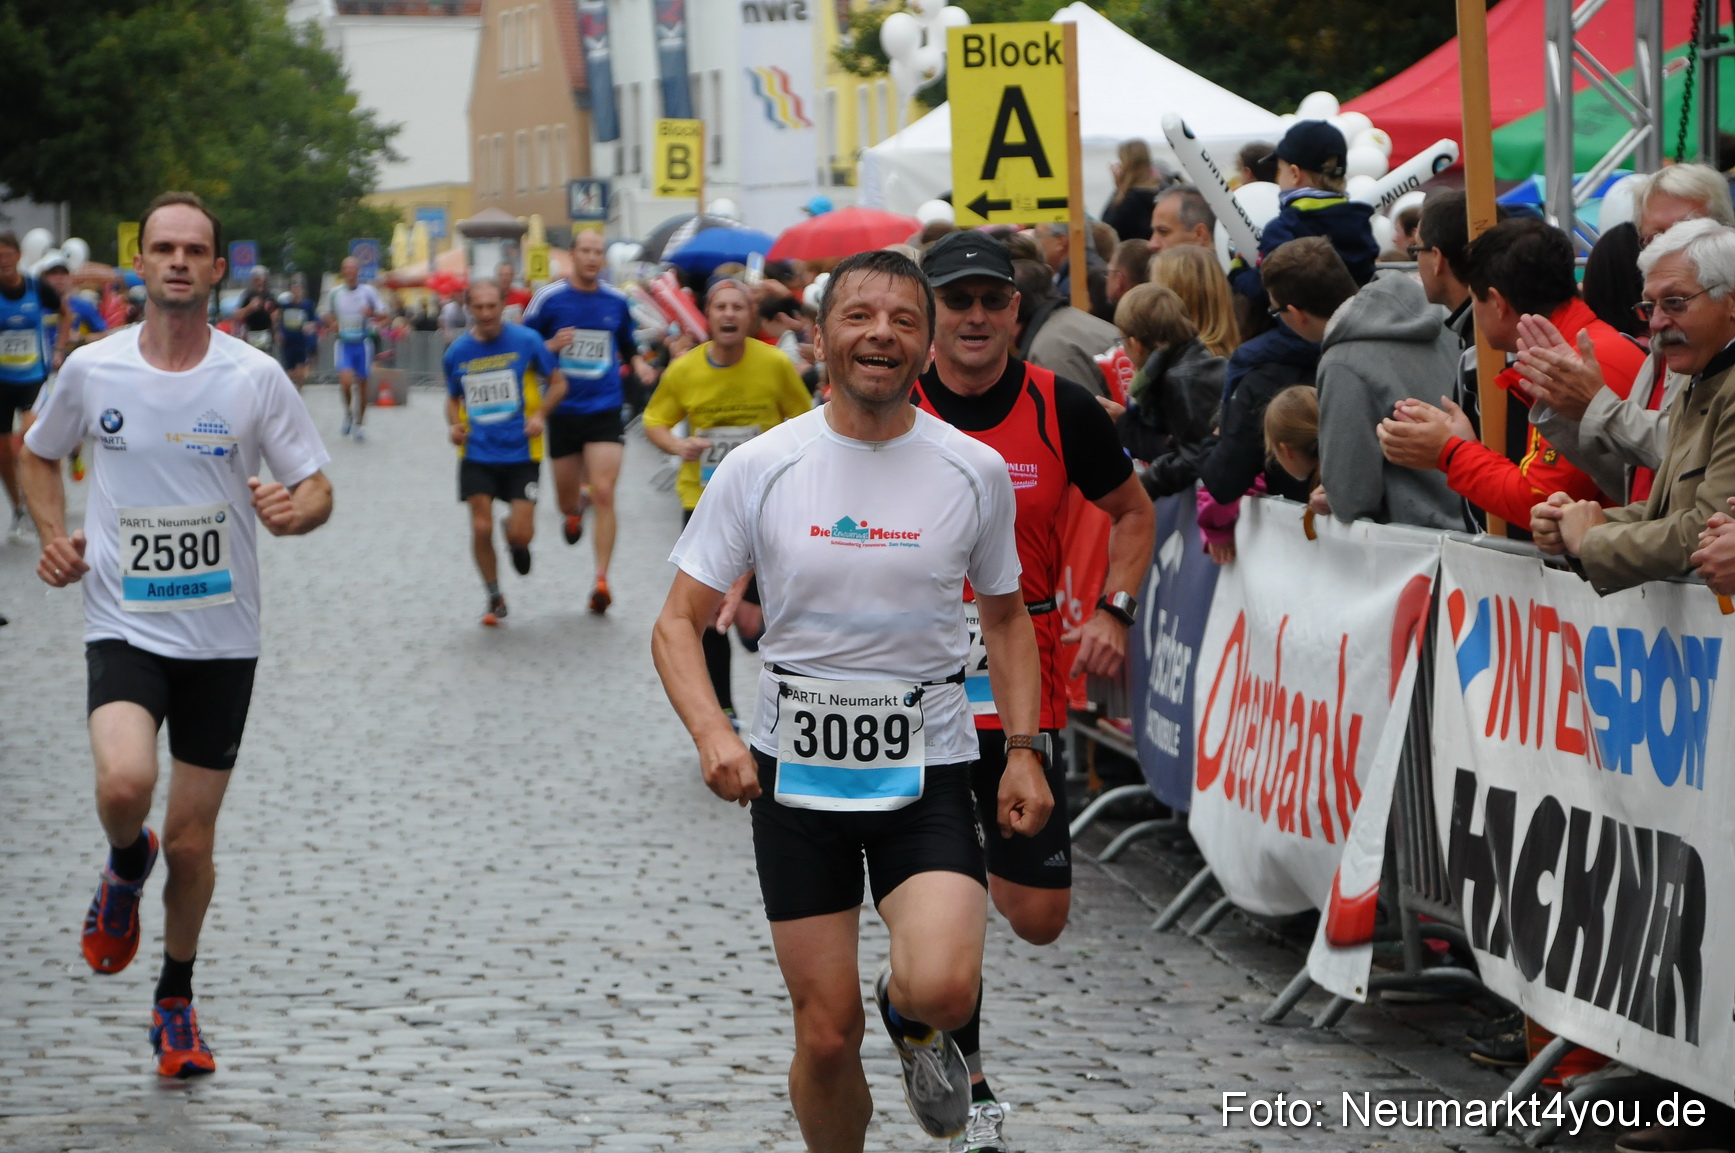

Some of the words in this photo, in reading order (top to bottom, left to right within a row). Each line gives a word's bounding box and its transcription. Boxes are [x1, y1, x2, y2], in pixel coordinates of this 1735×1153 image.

[963, 31, 1064, 68] Block
[979, 85, 1055, 181] A
[667, 143, 692, 180] B
[120, 517, 155, 529] PARTL
[157, 515, 212, 528] Neumarkt
[810, 525, 831, 538] Die
[130, 528, 221, 572] 2580
[146, 581, 208, 598] Andreas
[787, 688, 827, 705] PARTL
[829, 693, 898, 707] Neumarkt
[793, 709, 911, 762] 3089
[1196, 608, 1364, 845] Oberbank
